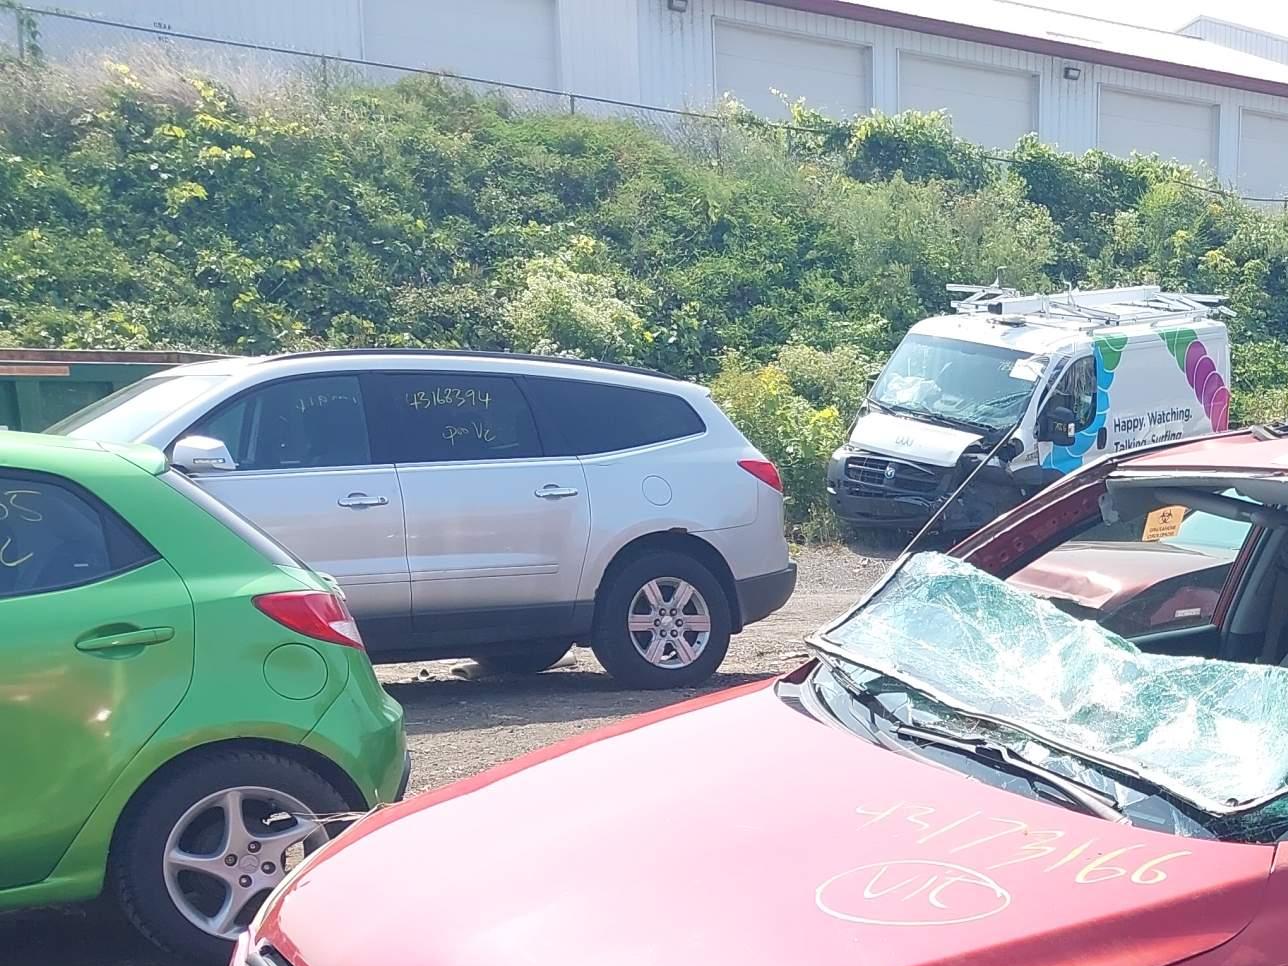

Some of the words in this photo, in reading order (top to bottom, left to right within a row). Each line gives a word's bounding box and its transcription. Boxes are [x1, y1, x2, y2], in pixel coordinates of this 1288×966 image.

[1114, 416, 1146, 433] Happy.
[1147, 407, 1192, 426] Watching.
[855, 800, 1193, 885] 43173166
